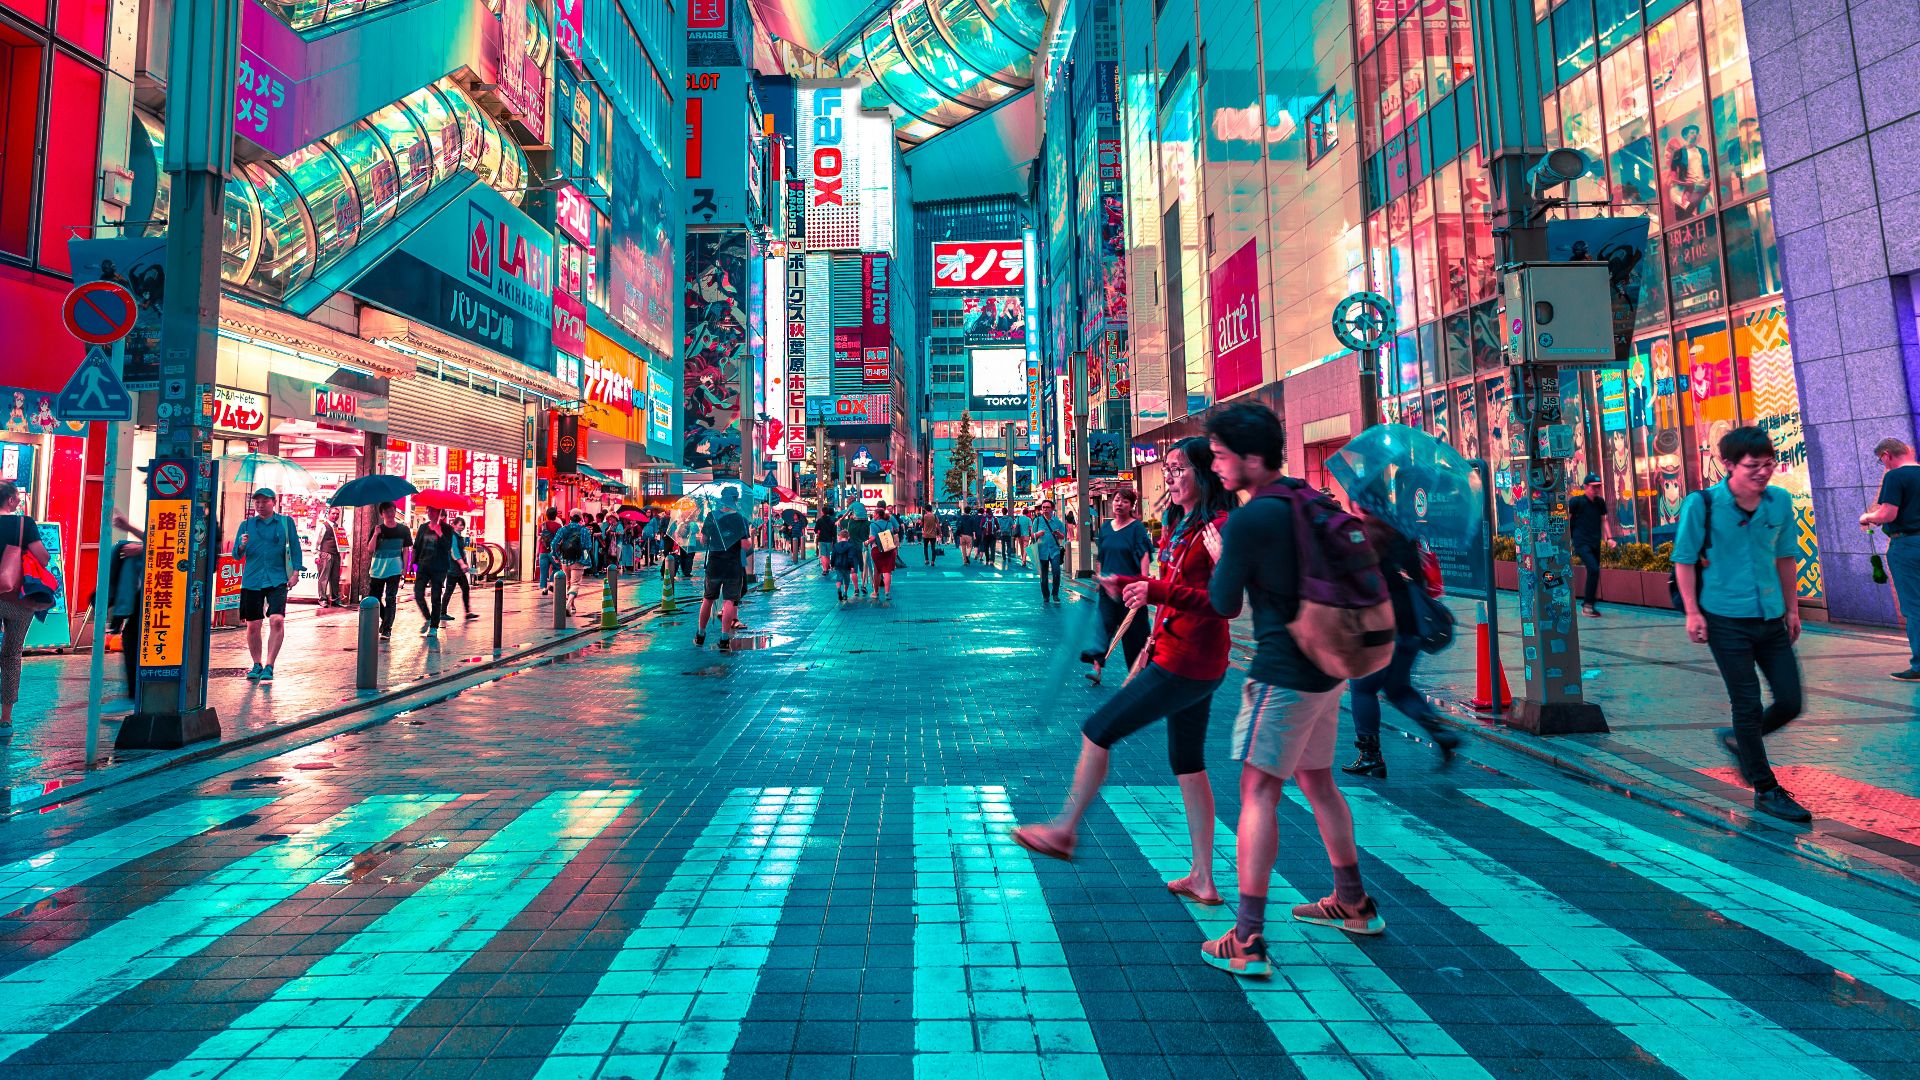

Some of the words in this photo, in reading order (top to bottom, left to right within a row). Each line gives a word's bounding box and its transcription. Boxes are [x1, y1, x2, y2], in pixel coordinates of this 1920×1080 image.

[687, 31, 728, 39] ARADISE
[240, 60, 285, 108] カメラ
[1099, 112, 1111, 122] 7F
[1102, 167, 1112, 176] 6F
[499, 221, 550, 298] LABI
[498, 277, 550, 321] AKIHABARA
[450, 289, 514, 350] パソコン館
[789, 254, 805, 460] ボークス秋葉原ホビー天国
[1543, 378, 1556, 386] JS
[330, 391, 357, 415] LABI
[984, 397, 1022, 406] TOKYO
[1543, 397, 1557, 405] JS
[177, 504, 188, 555] 千代田区内は
[221, 564, 243, 579] au
[152, 512, 177, 661] 路上喫煙禁止です。
